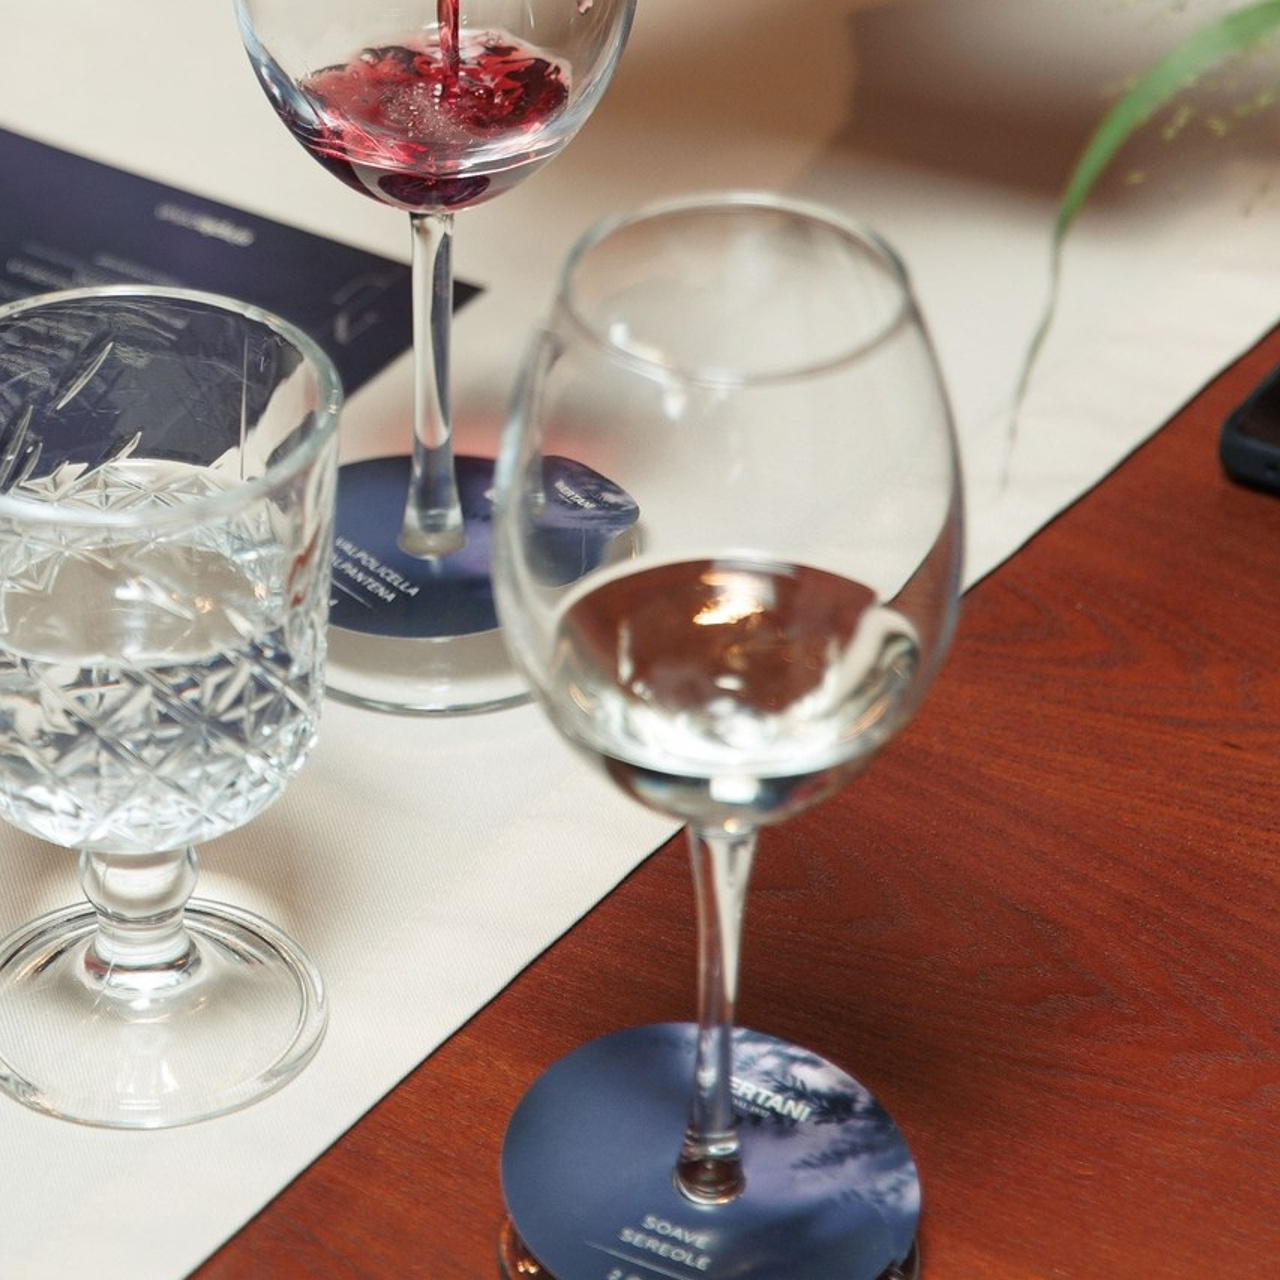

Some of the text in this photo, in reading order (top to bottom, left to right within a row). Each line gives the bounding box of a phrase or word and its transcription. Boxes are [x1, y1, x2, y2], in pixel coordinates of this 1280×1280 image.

[331, 554, 397, 603] LPANTENA
[729, 1075, 813, 1122] ERTANI
[620, 1227, 712, 1273] SEREOLE
[641, 1215, 711, 1251] SOAVE
